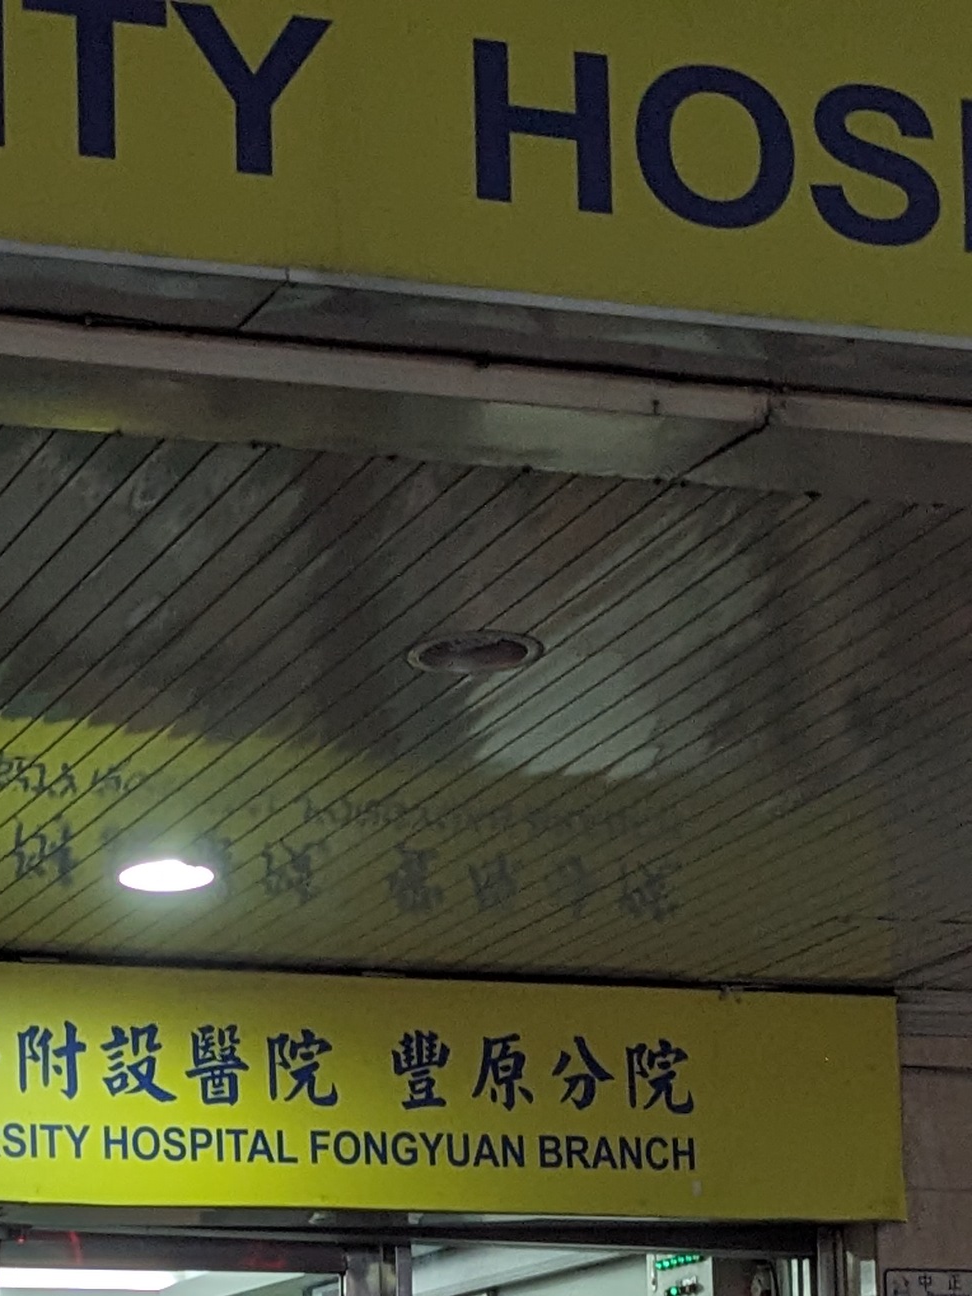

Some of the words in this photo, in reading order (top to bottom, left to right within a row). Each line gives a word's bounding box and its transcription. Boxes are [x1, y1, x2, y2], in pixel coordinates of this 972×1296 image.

[477, 41, 972, 250] HOS
[393, 1030, 694, 1113] 豐原分院
[105, 1124, 298, 1164] HOSPITAL
[311, 1130, 526, 1169] FONGYUAN
[539, 1136, 696, 1172] BRANCH
